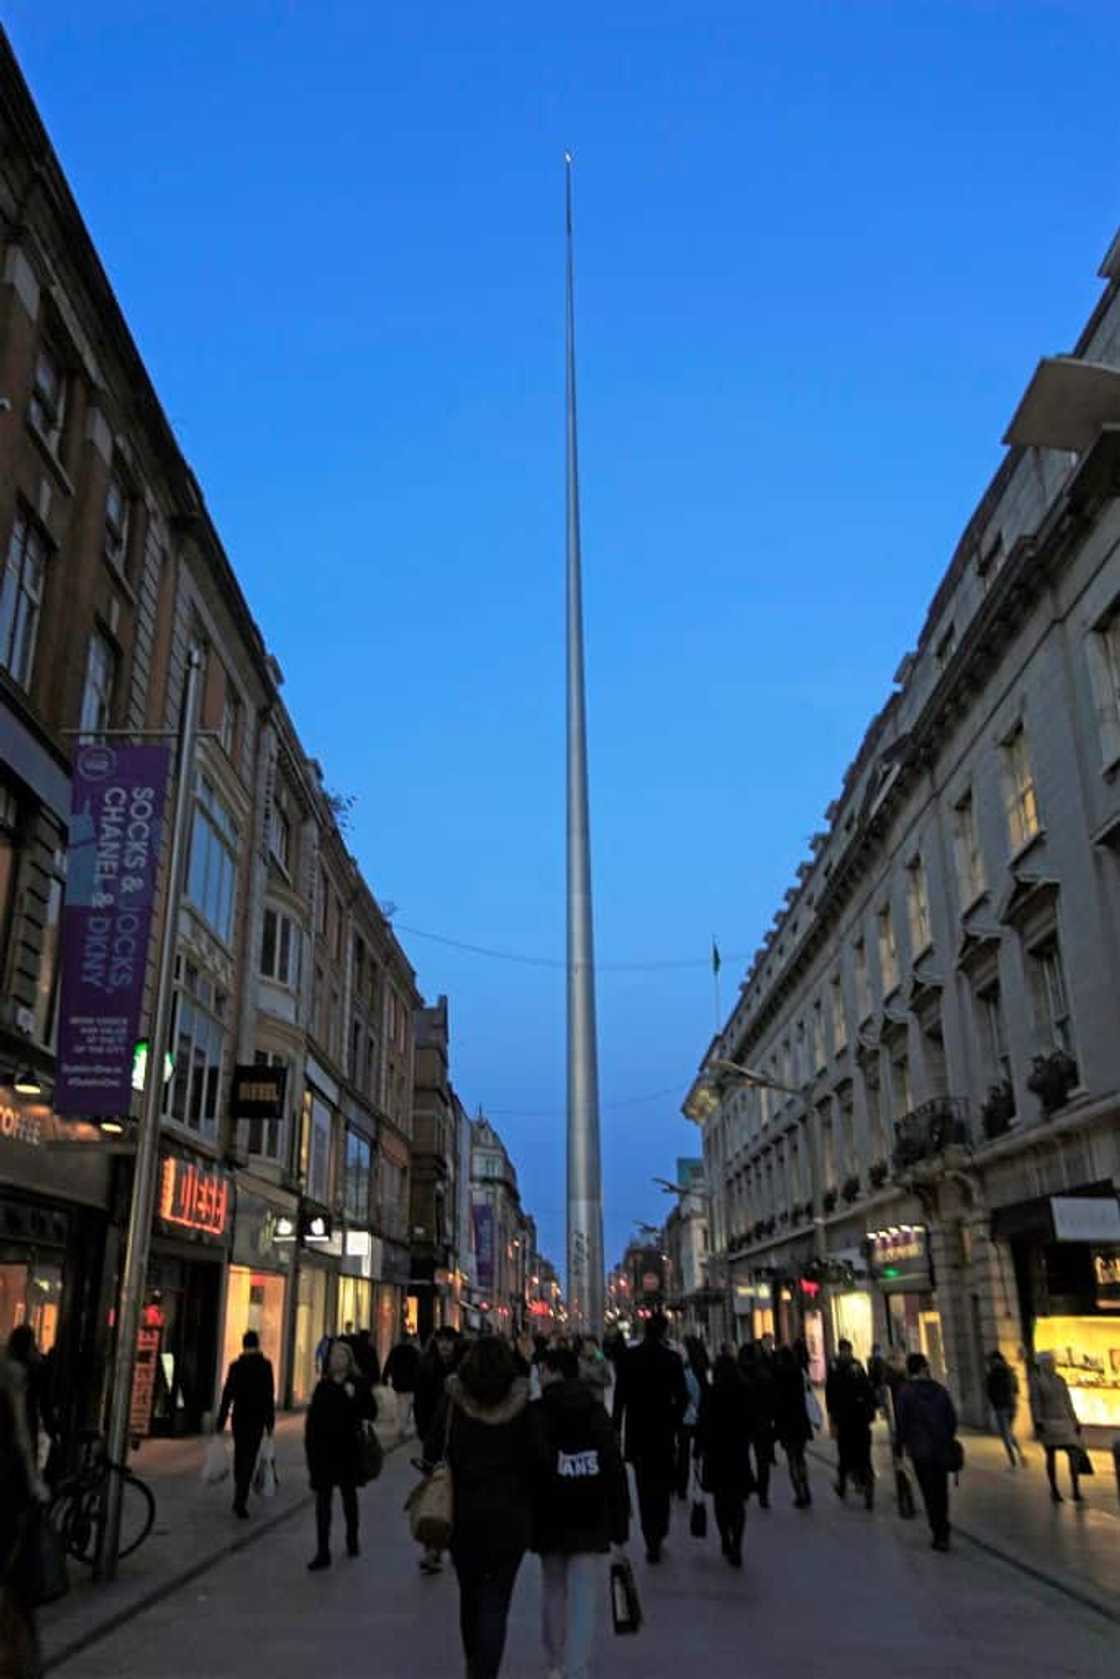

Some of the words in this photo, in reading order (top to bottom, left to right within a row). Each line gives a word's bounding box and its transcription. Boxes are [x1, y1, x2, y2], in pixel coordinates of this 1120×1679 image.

[95, 786, 126, 880] CHANEL
[125, 785, 155, 870] SOCKS
[92, 892, 115, 909] &
[120, 877, 145, 894] &
[82, 917, 110, 988] DKNY
[557, 1449, 600, 1478] VANS
